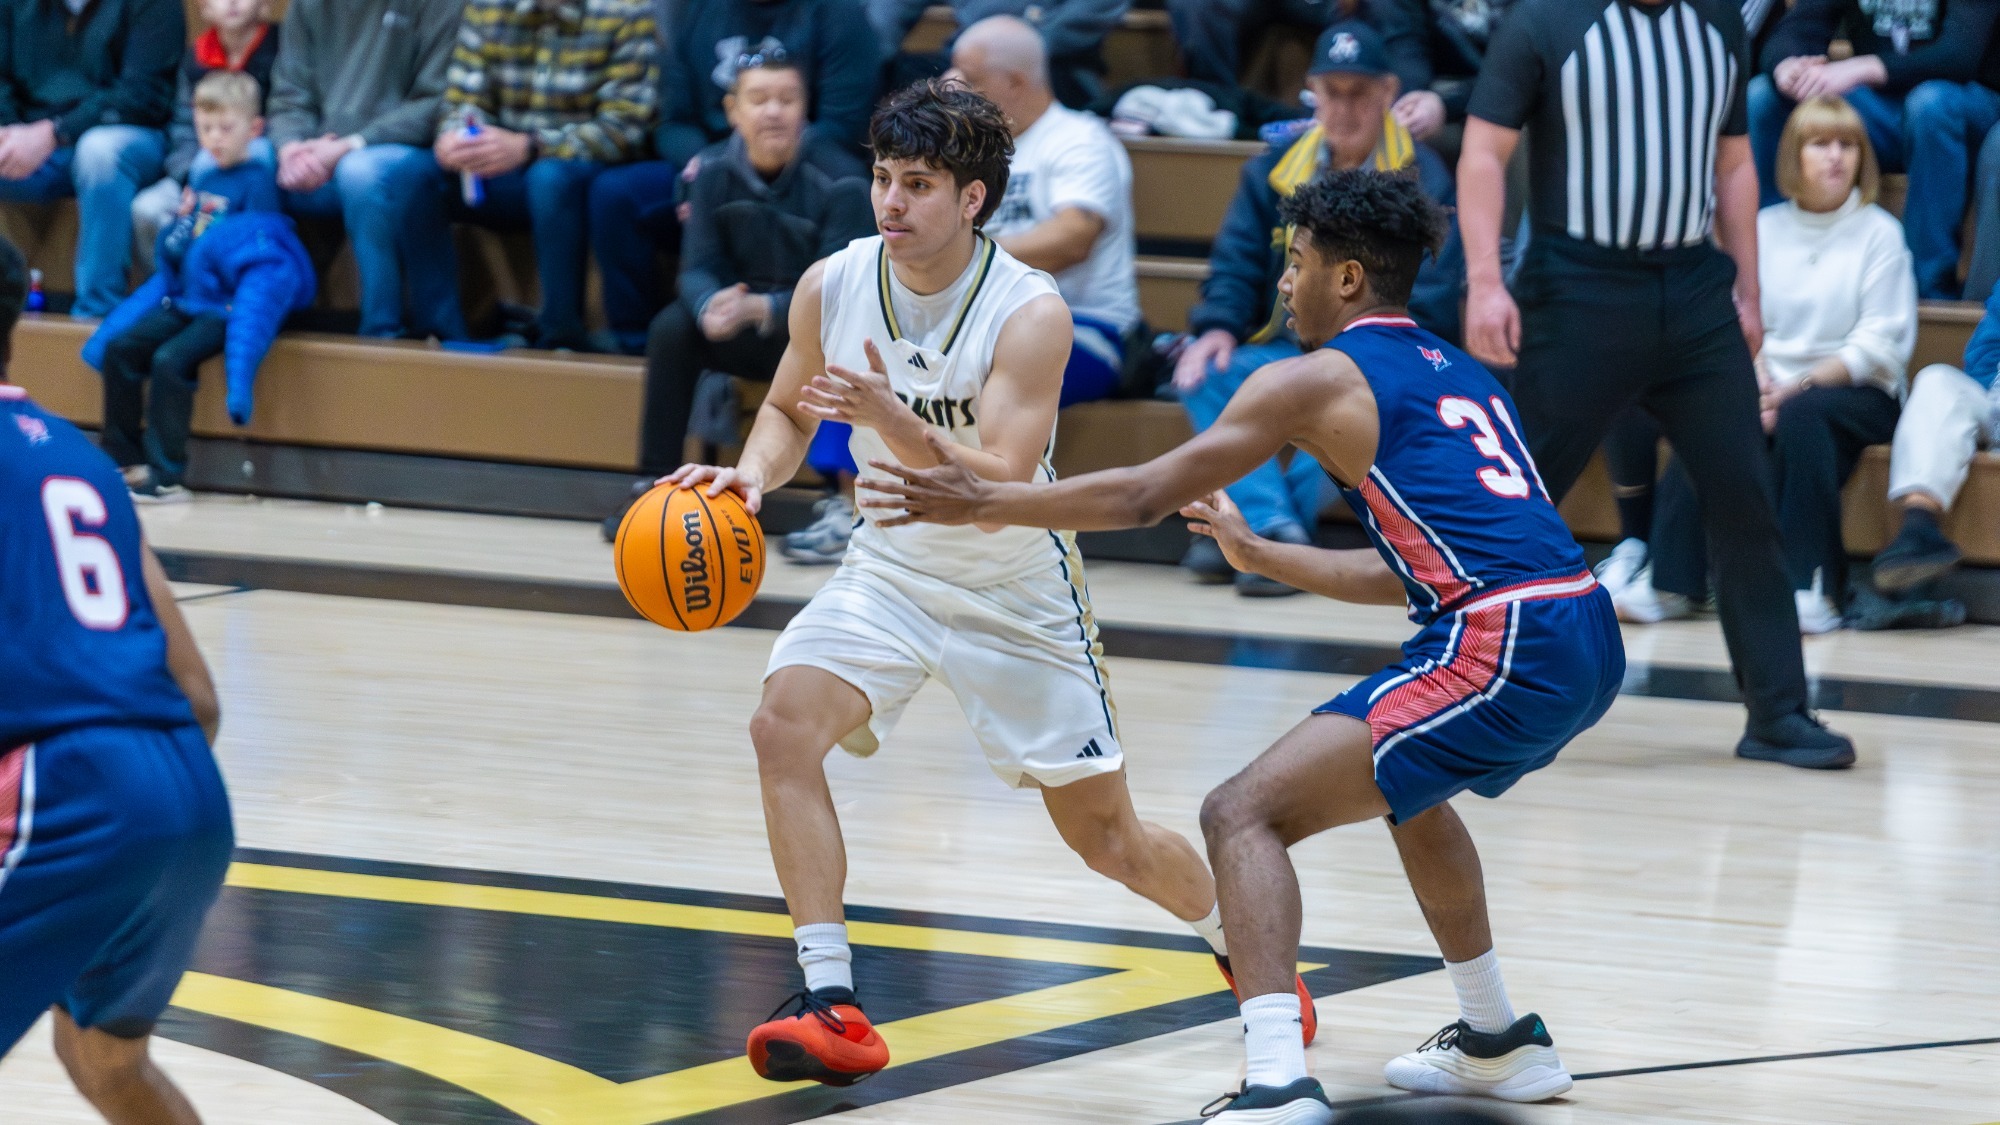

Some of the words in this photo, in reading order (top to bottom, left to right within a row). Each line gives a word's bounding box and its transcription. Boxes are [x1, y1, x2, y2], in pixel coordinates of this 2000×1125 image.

[1436, 394, 1553, 505] 31
[41, 475, 130, 632] 6
[681, 509, 712, 613] Wilson
